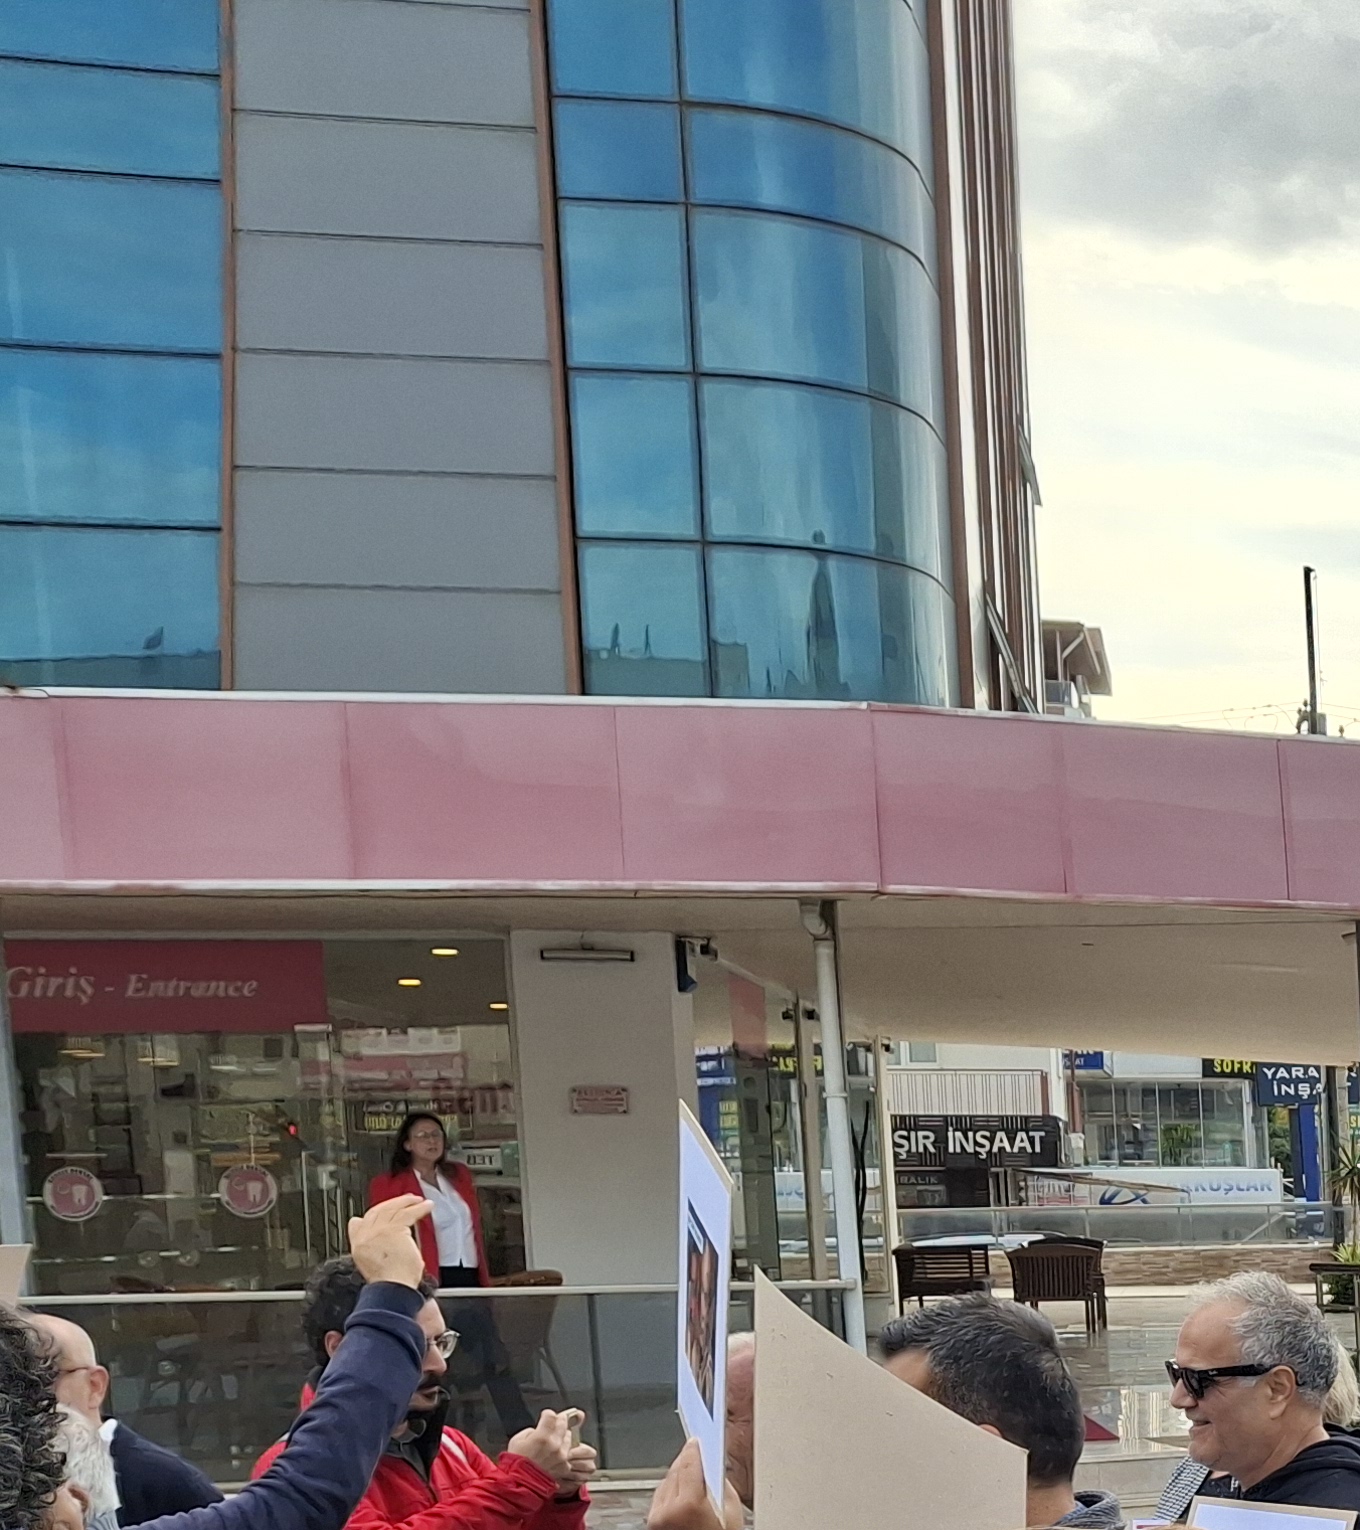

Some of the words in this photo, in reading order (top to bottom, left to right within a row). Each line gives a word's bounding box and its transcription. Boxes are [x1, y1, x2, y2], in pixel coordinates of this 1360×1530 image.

[4, 966, 95, 1006] Giriş
[125, 973, 259, 998] Entrance
[1213, 1058, 1256, 1073] SOFR
[947, 1126, 1046, 1160] İNŞAAT
